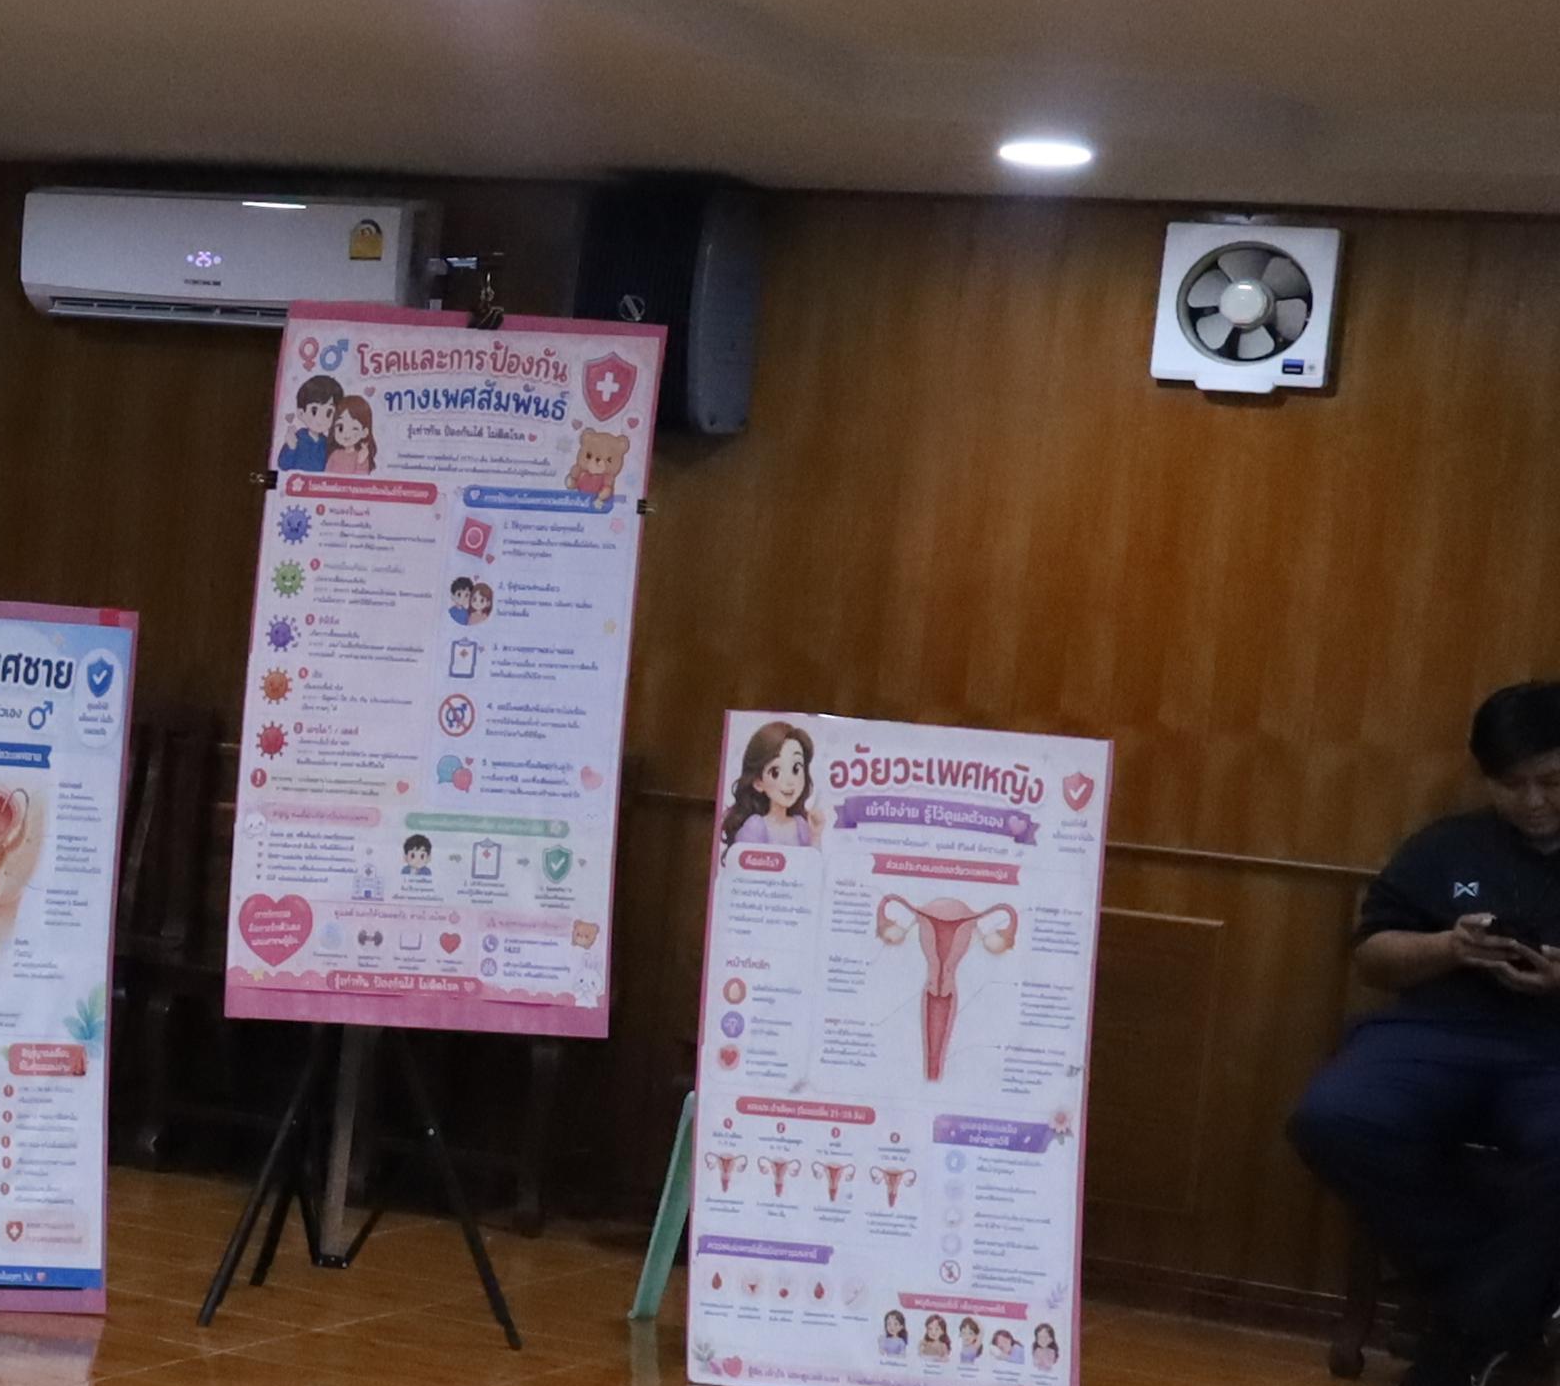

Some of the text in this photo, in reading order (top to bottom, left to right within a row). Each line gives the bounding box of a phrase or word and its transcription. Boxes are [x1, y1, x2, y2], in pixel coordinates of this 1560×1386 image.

[356, 340, 569, 384] โรคและการป้องกัน
[383, 380, 570, 422] ทางเพศสัมพันธ์
[828, 743, 1045, 805] อวัยวะเพศหญิง
[865, 801, 1005, 831] เข้าใจง่าย รู้ไว้ดูแลตัวเอง
